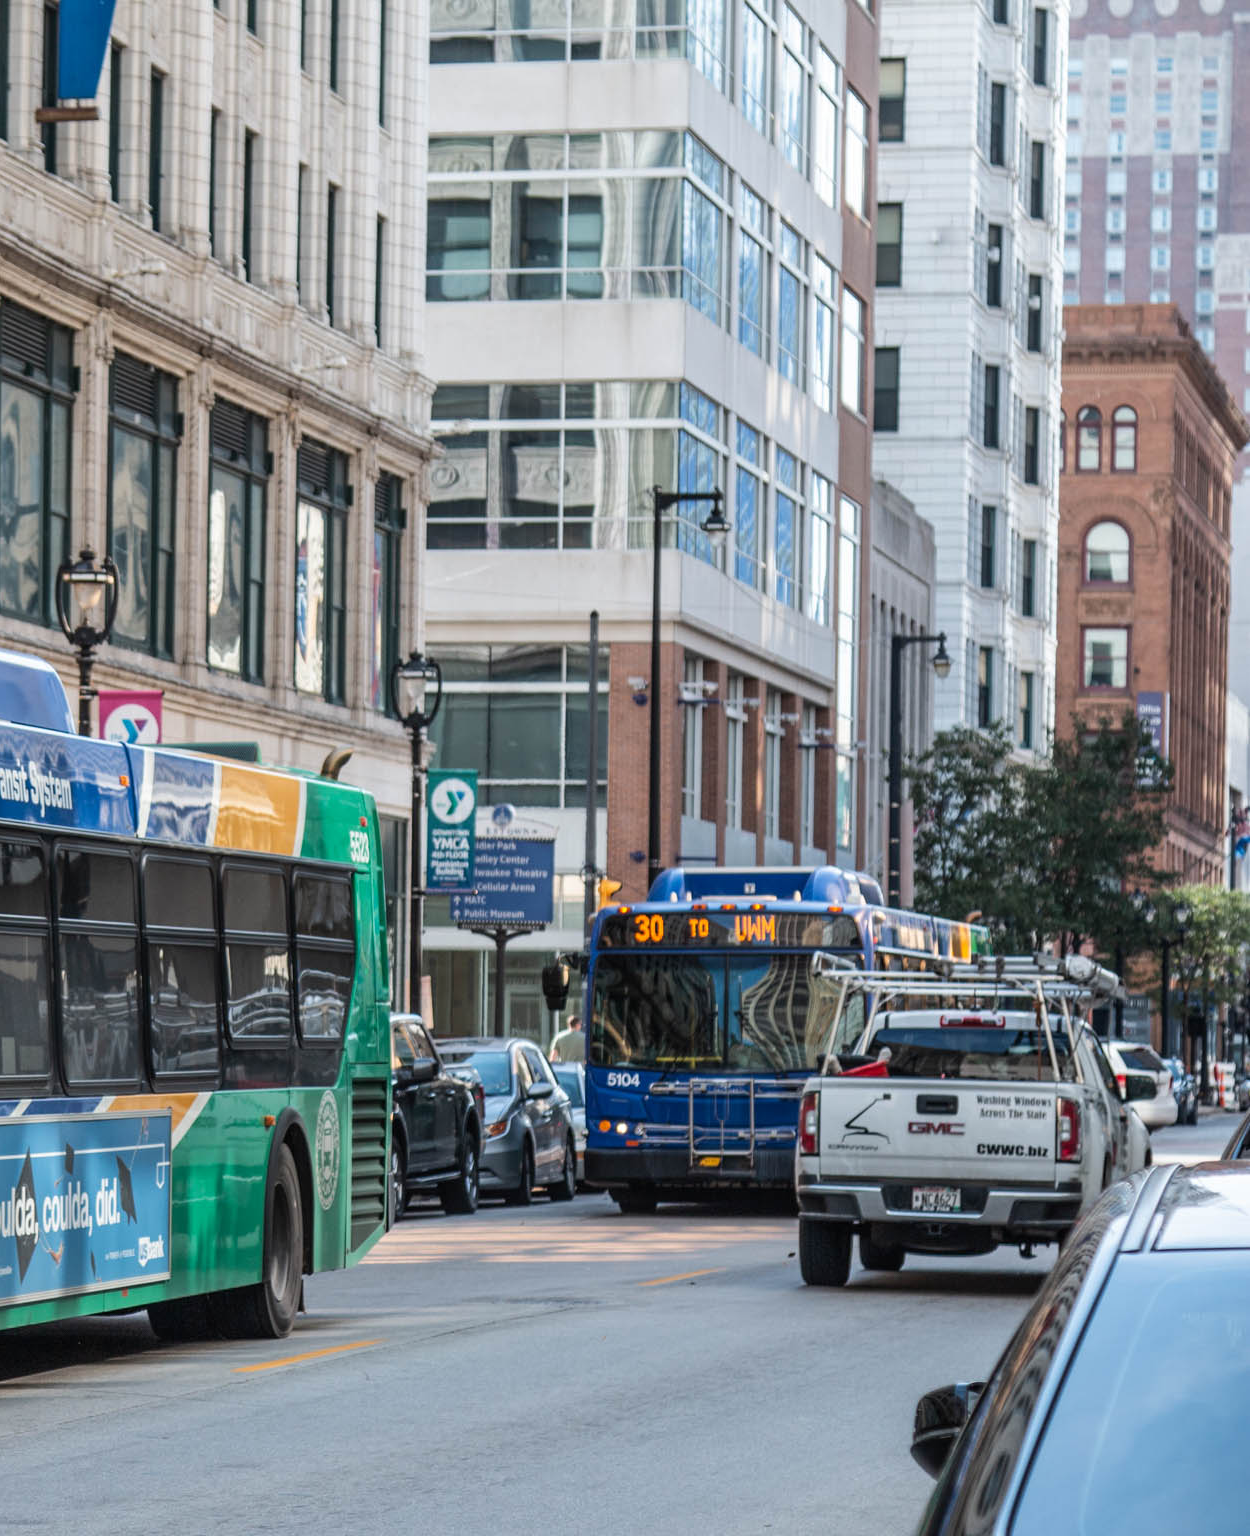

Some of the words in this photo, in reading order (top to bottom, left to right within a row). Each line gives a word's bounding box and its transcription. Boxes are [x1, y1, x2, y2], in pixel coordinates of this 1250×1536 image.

[28, 760, 73, 818] System
[349, 830, 370, 864] 5523
[432, 837, 470, 850] YMCA
[497, 840, 517, 851] Park
[445, 851, 469, 859] FLOOR
[499, 855, 530, 865] Center
[475, 867, 511, 878] lwaukee
[514, 868, 548, 879] Theatre
[477, 882, 509, 891] Cellular
[510, 882, 536, 893] Arena
[464, 909, 488, 918] Public
[490, 909, 525, 919] Museum
[634, 914, 664, 942] 30
[688, 918, 709, 938] TO
[734, 914, 776, 942] UWM
[607, 1072, 640, 1088] 5104
[976, 1095, 1011, 1107] Washing
[1014, 1096, 1052, 1107] Windows
[980, 1108, 1006, 1119] Across
[1009, 1109, 1024, 1119] The
[1026, 1111, 1047, 1120] State
[907, 1121, 966, 1136] GMC
[976, 1142, 1049, 1158] CWWC.biz
[42, 1180, 93, 1237] coulda,
[95, 1177, 121, 1226] did.
